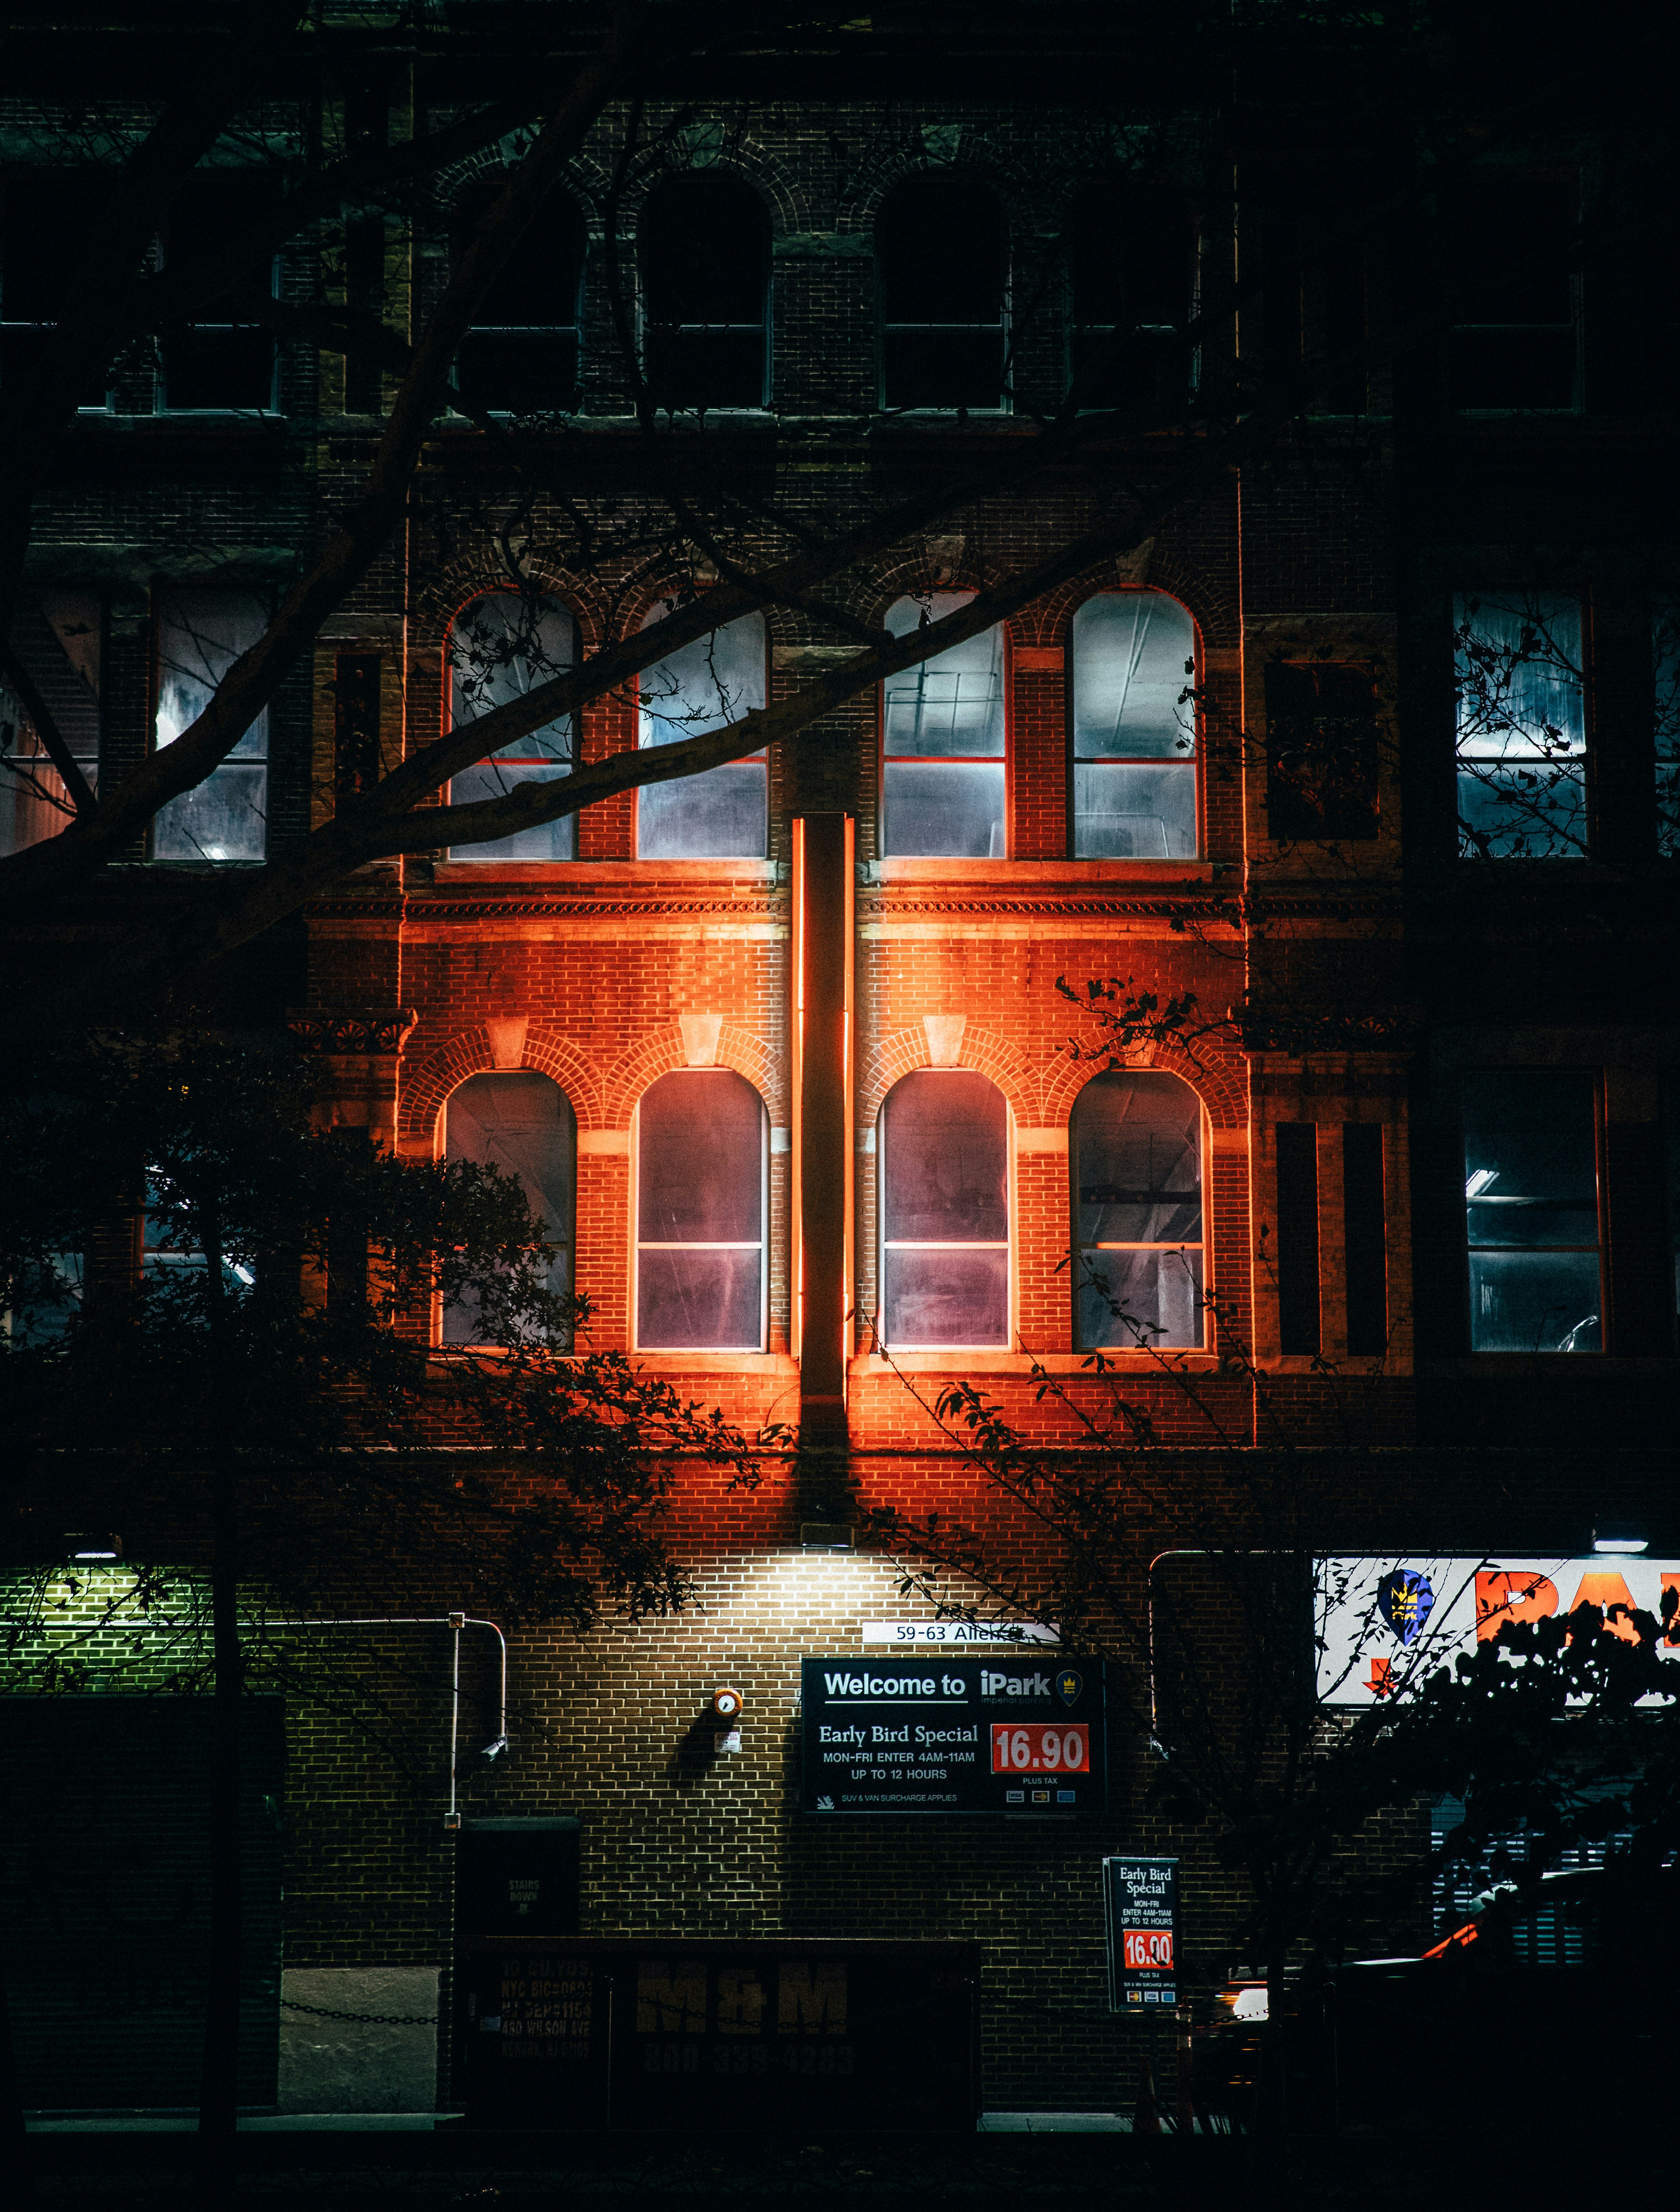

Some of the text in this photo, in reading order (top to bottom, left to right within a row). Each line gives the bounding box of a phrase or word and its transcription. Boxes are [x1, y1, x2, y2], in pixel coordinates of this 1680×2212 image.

[1475, 1571, 1680, 1648] PA
[897, 1627, 945, 1640] 59-63
[824, 1673, 965, 1695] Welcome to
[981, 1670, 1051, 1695] iPark
[819, 1725, 978, 1747] Early Bird Special
[823, 1753, 975, 1762] MON-FRI ENTER 4AM-11AM
[996, 1731, 1083, 1768] 16.90
[852, 1769, 947, 1779] UP TO 12 HOURS
[1120, 1867, 1171, 1885] Early Bird
[509, 1880, 539, 1890] STAIRS
[1127, 1881, 1165, 1897] Special
[510, 1892, 537, 1901] DOWN
[1126, 1935, 1170, 1964] 16.90
[502, 1980, 526, 1997] NYC
[636, 1961, 847, 2034] M&M
[571, 2020, 590, 2037] AVE
